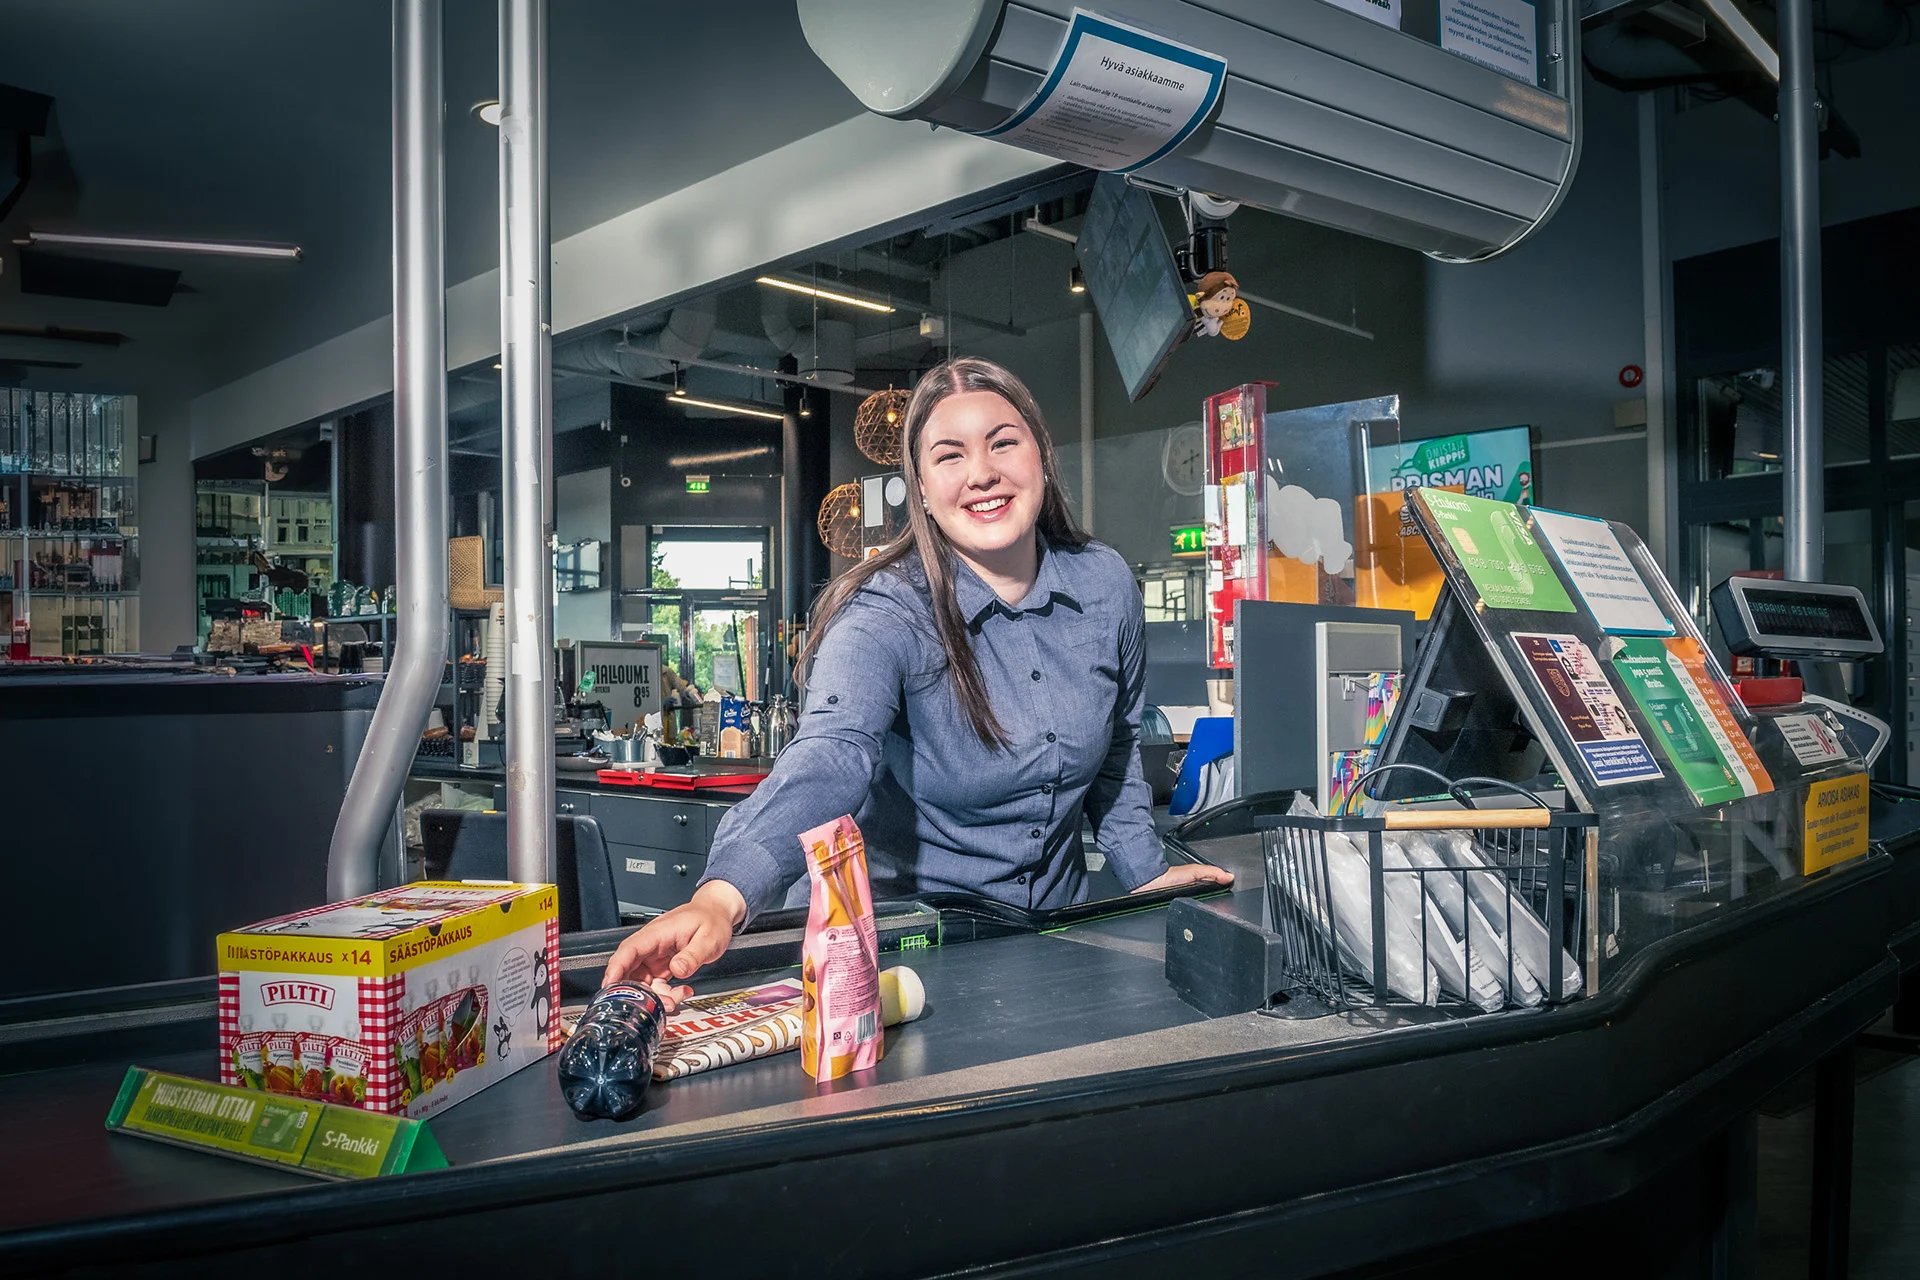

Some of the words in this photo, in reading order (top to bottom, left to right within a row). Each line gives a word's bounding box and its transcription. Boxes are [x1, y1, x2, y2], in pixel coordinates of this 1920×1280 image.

[1448, 27, 1464, 39] myynti
[1465, 33, 1474, 42] alle
[1475, 37, 1504, 54] 18-vuotiaalle
[1100, 56, 1124, 75] Hyvä
[1124, 62, 1185, 92] asiakkaamme
[1081, 83, 1101, 94] mukaan
[1101, 89, 1111, 97] alle
[1111, 91, 1141, 106] 18-vuotiaalle
[1426, 440, 1464, 460] OMISTAJA
[1428, 449, 1466, 470] KIRPPIS
[1425, 493, 1472, 513] S-Etukortti
[1509, 511, 1534, 546] VISA
[1748, 601, 1786, 615] EURAAVA
[1790, 605, 1830, 618] ASIAKAS
[591, 664, 649, 685] HALLOUMI
[1818, 788, 1840, 808] ARVOISA
[1840, 783, 1860, 802] ASIAKAS
[539, 896, 553, 911] x14
[389, 925, 473, 964] SÄÄSTÖPAKKAUS
[267, 984, 328, 1006] PILTTI
[665, 1001, 796, 1039] ALEHTI
[239, 1041, 261, 1053] PILTT
[269, 1040, 293, 1051] PILTT
[302, 1042, 326, 1053] PILTT
[334, 1047, 363, 1062] PILTTI
[150, 1083, 219, 1116] MUISTATHAN
[218, 1095, 256, 1124] OTTAA
[322, 1129, 380, 1157] S-Pankki
